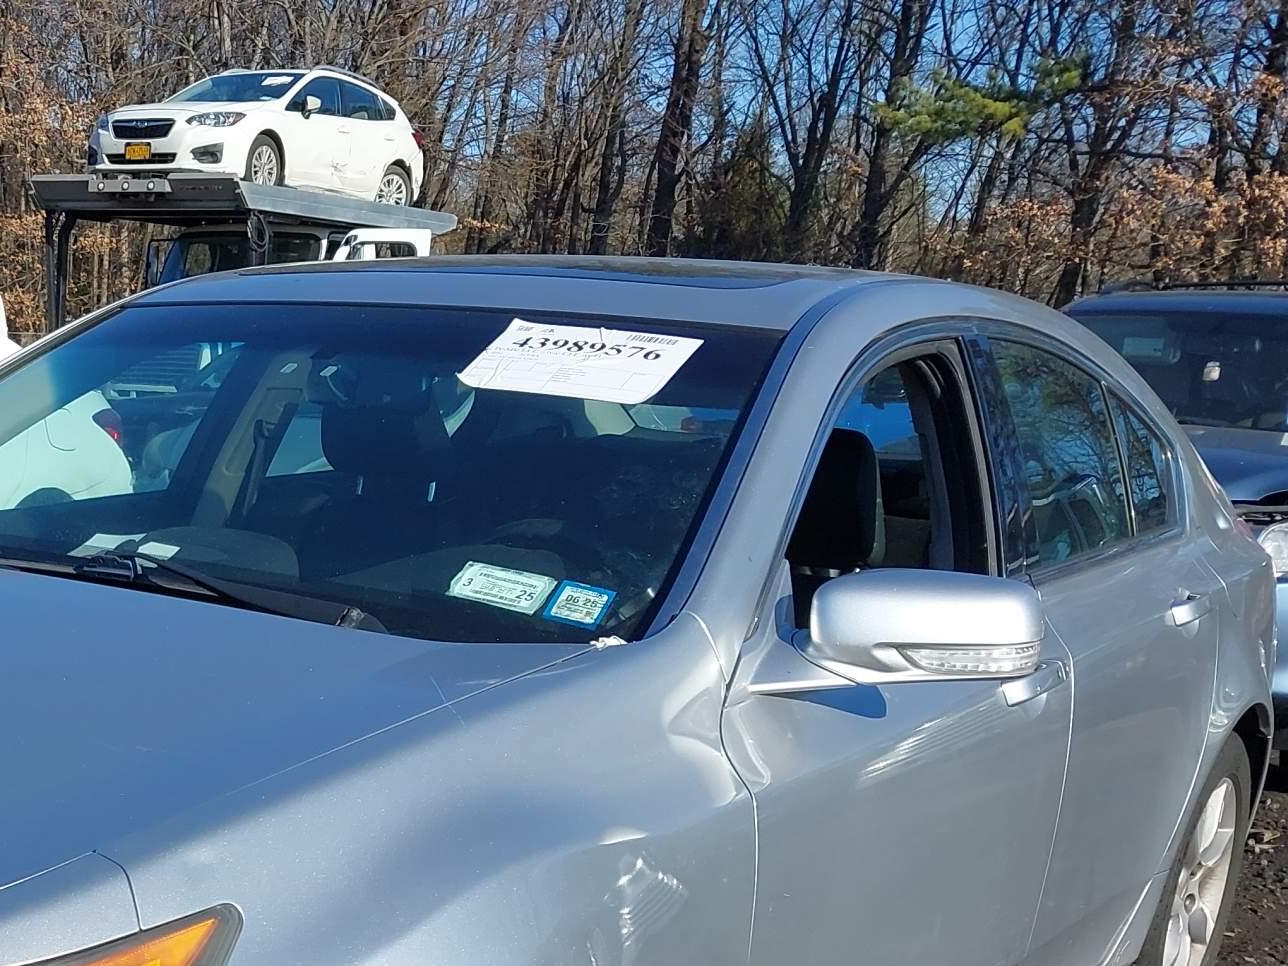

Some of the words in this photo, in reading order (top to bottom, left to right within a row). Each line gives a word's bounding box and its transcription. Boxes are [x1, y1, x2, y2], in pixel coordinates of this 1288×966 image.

[512, 335, 667, 361] 43989576
[462, 577, 474, 587] 3
[515, 589, 537, 602] 25
